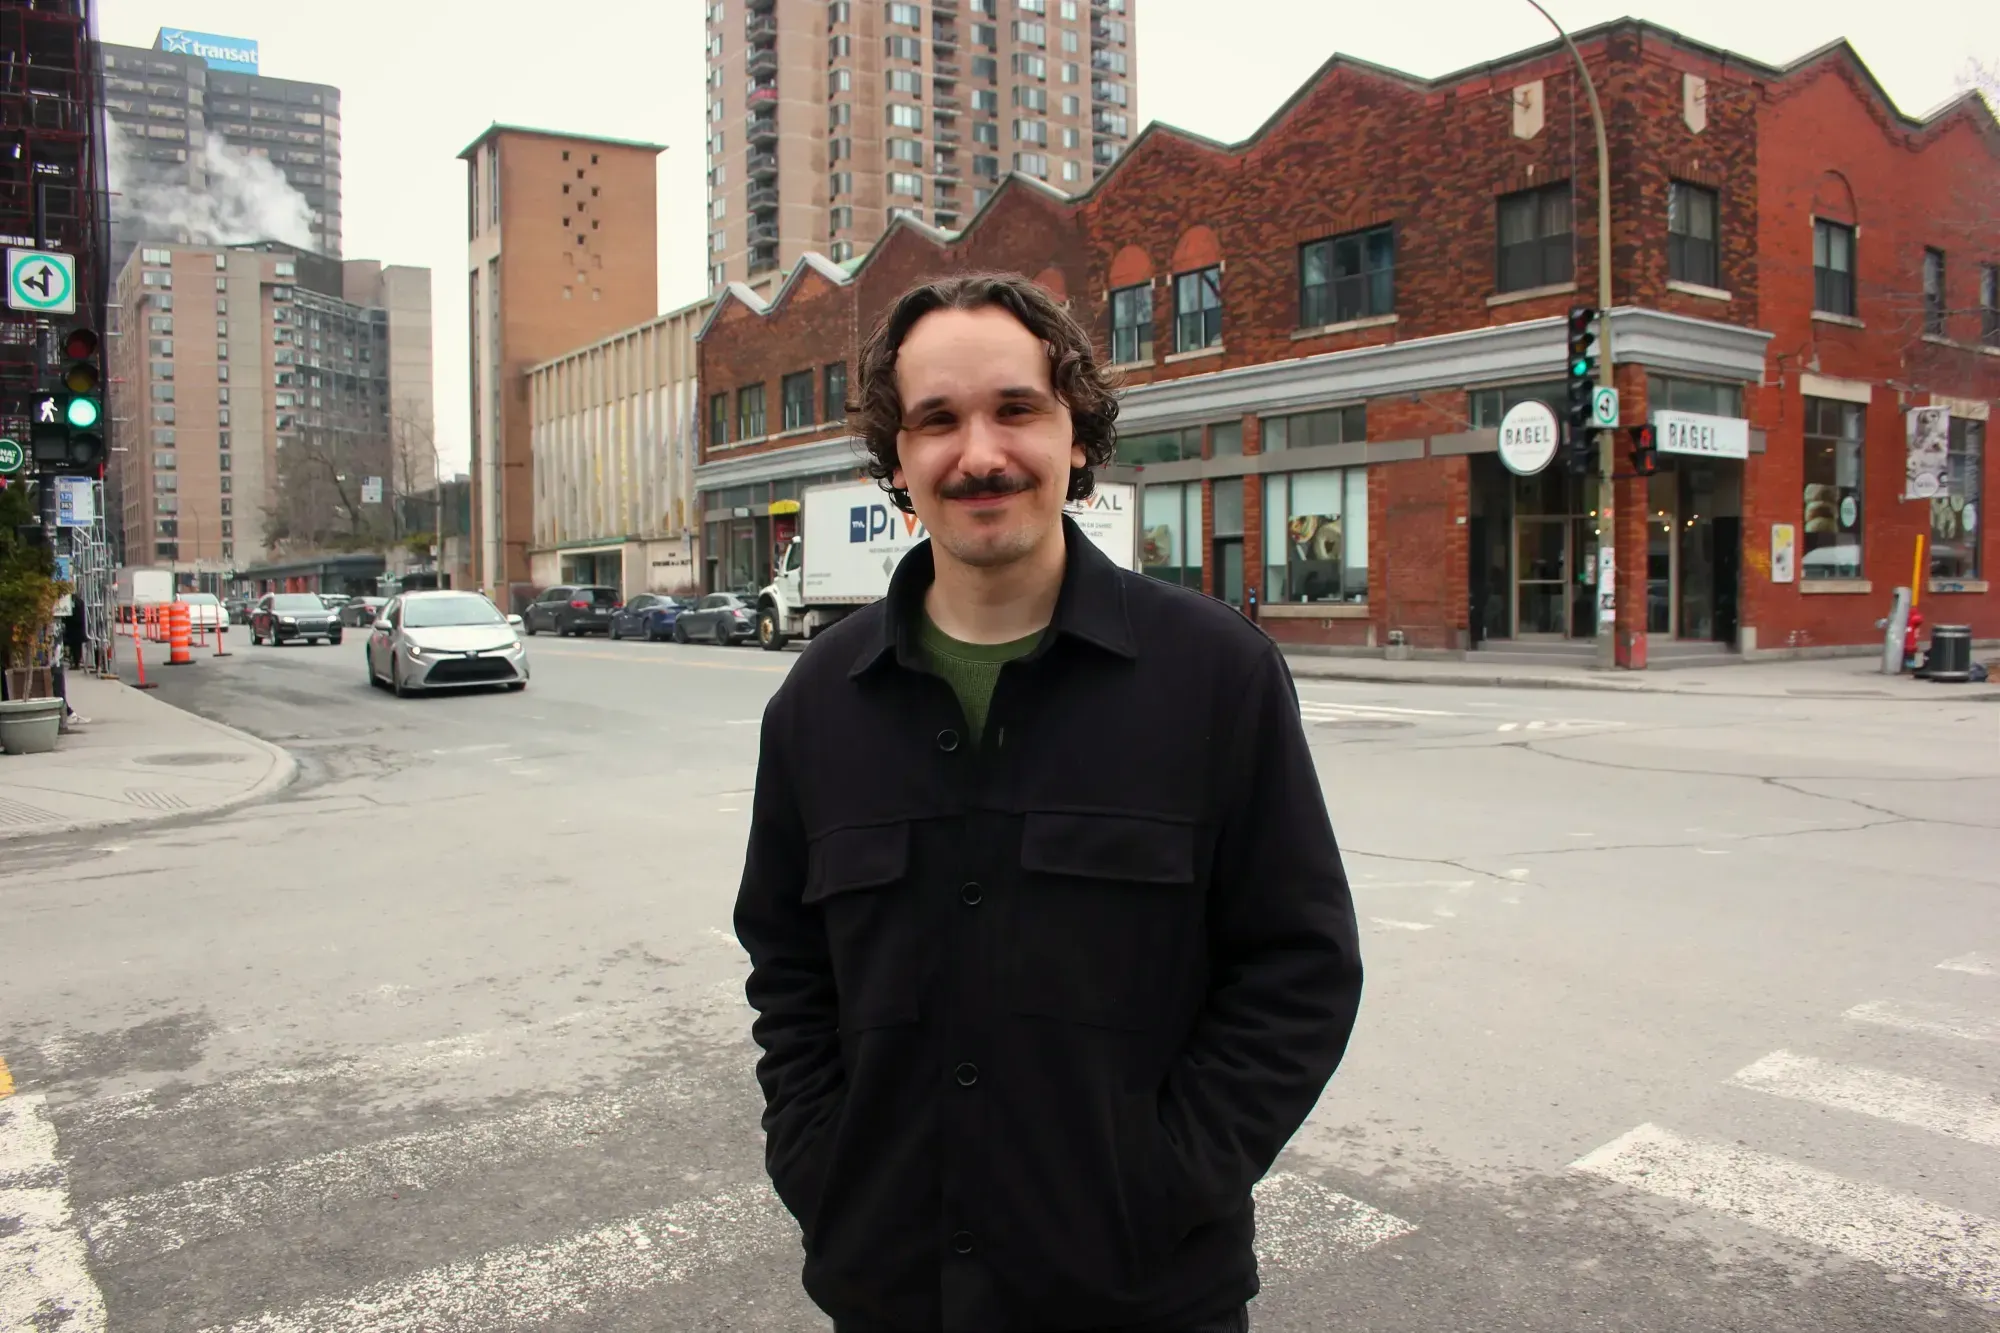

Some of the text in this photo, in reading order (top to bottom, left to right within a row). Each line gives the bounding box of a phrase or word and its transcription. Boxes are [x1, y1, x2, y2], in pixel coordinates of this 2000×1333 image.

[192, 40, 258, 64] transat
[1505, 426, 1550, 445] BAGEL
[1668, 422, 1719, 451] BAGEL
